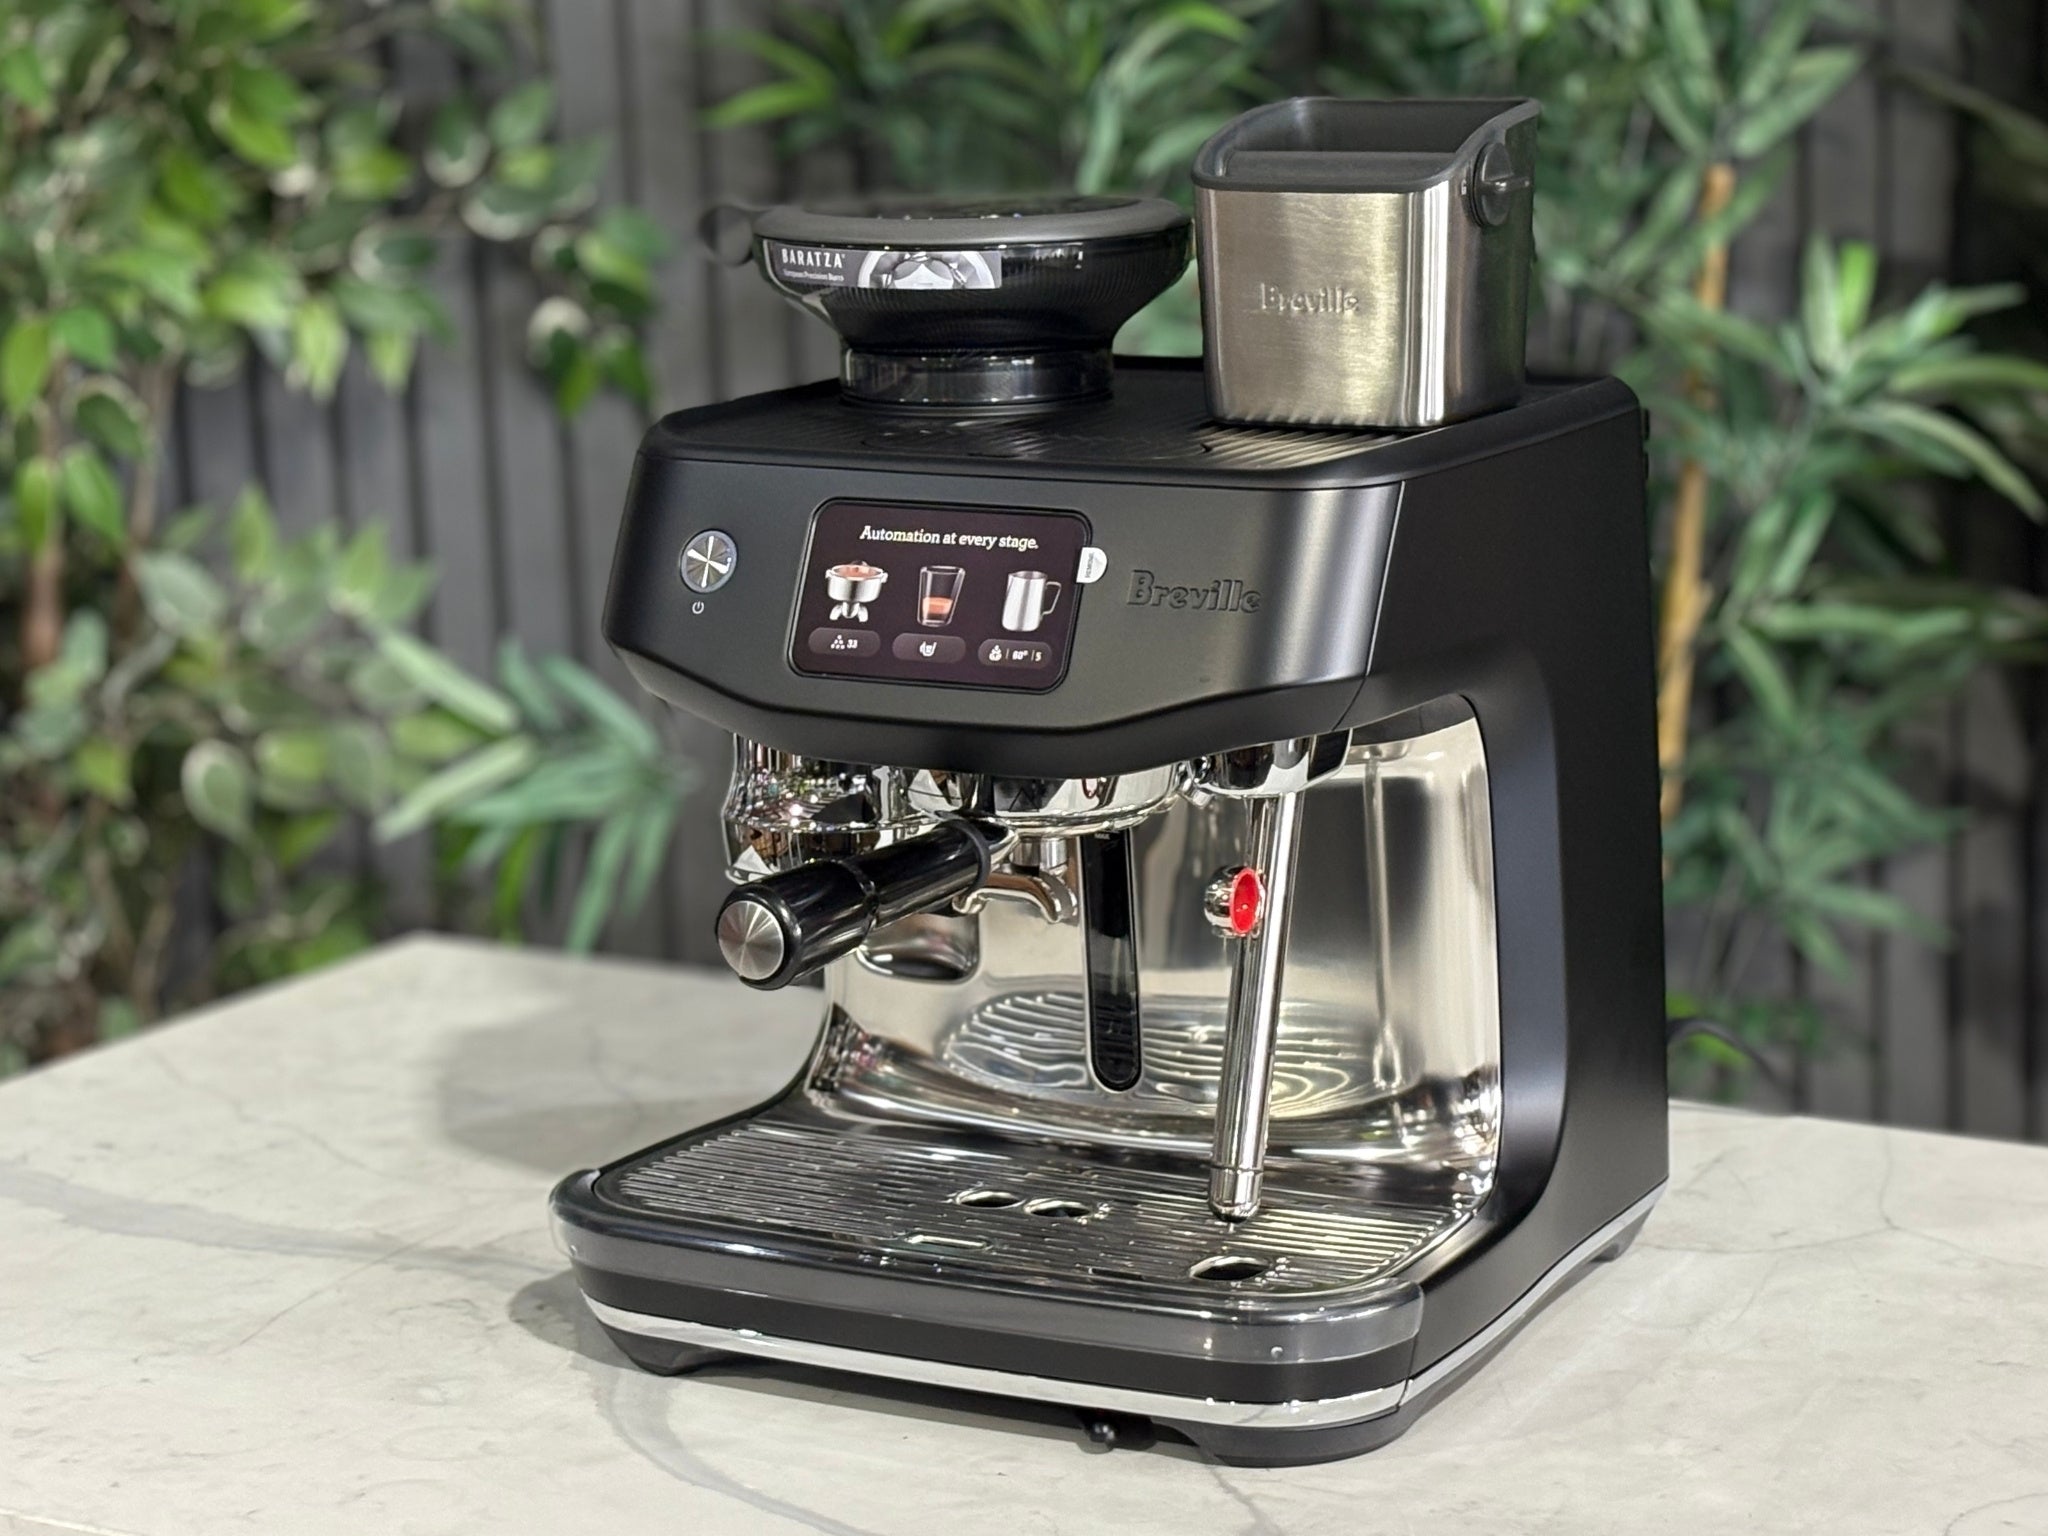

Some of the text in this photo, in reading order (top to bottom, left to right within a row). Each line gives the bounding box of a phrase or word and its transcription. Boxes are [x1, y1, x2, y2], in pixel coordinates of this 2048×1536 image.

[781, 248, 843, 269] BARATZA
[1260, 282, 1359, 313] Breville
[859, 525, 1039, 552] Automation at every stage.
[1127, 569, 1262, 613] Breville
